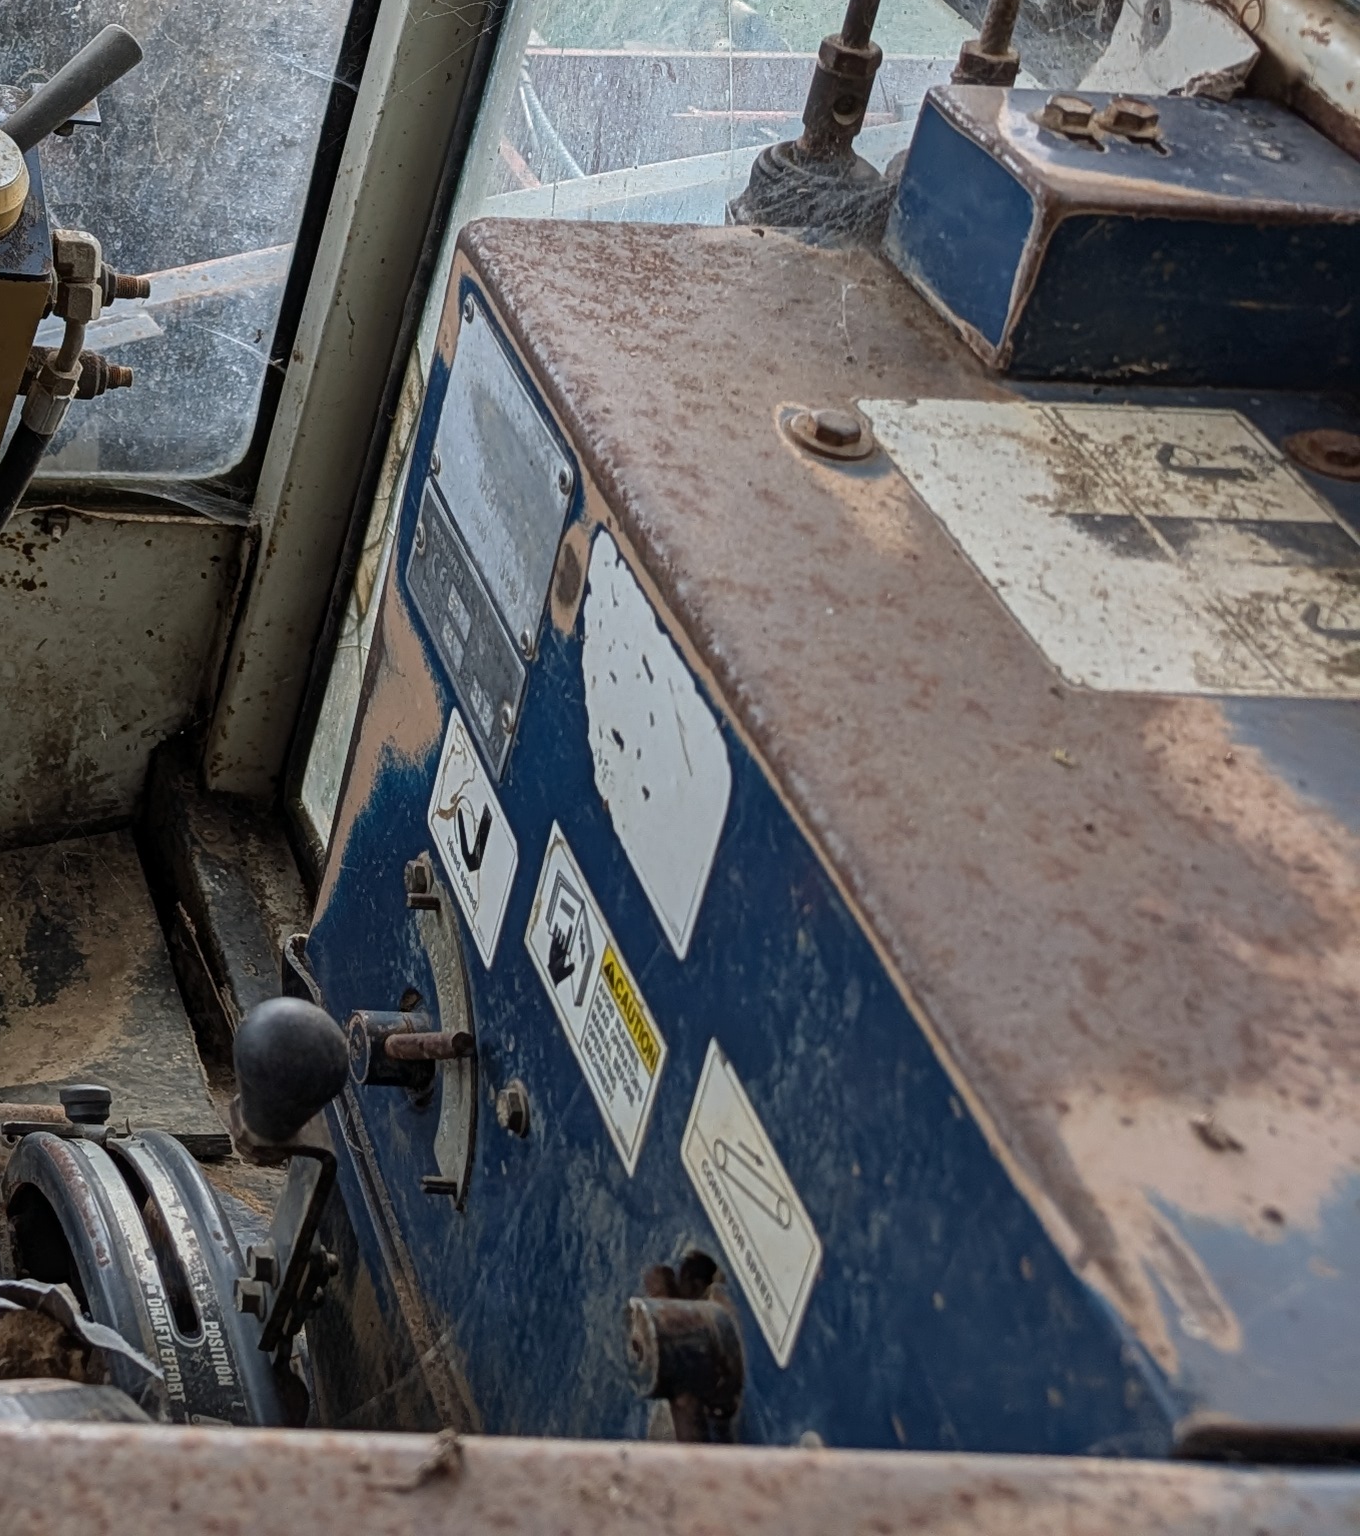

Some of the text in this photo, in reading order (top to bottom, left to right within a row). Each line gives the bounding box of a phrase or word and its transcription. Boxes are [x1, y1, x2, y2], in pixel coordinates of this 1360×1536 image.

[446, 834, 478, 910] Head speed
[594, 995, 610, 1027] READ
[615, 977, 657, 1070] CAUTION
[701, 1158, 773, 1310] CONVEYOR SPEED
[146, 1297, 186, 1403] DRAFT/EFFORT
[205, 1320, 235, 1387] POSITION
